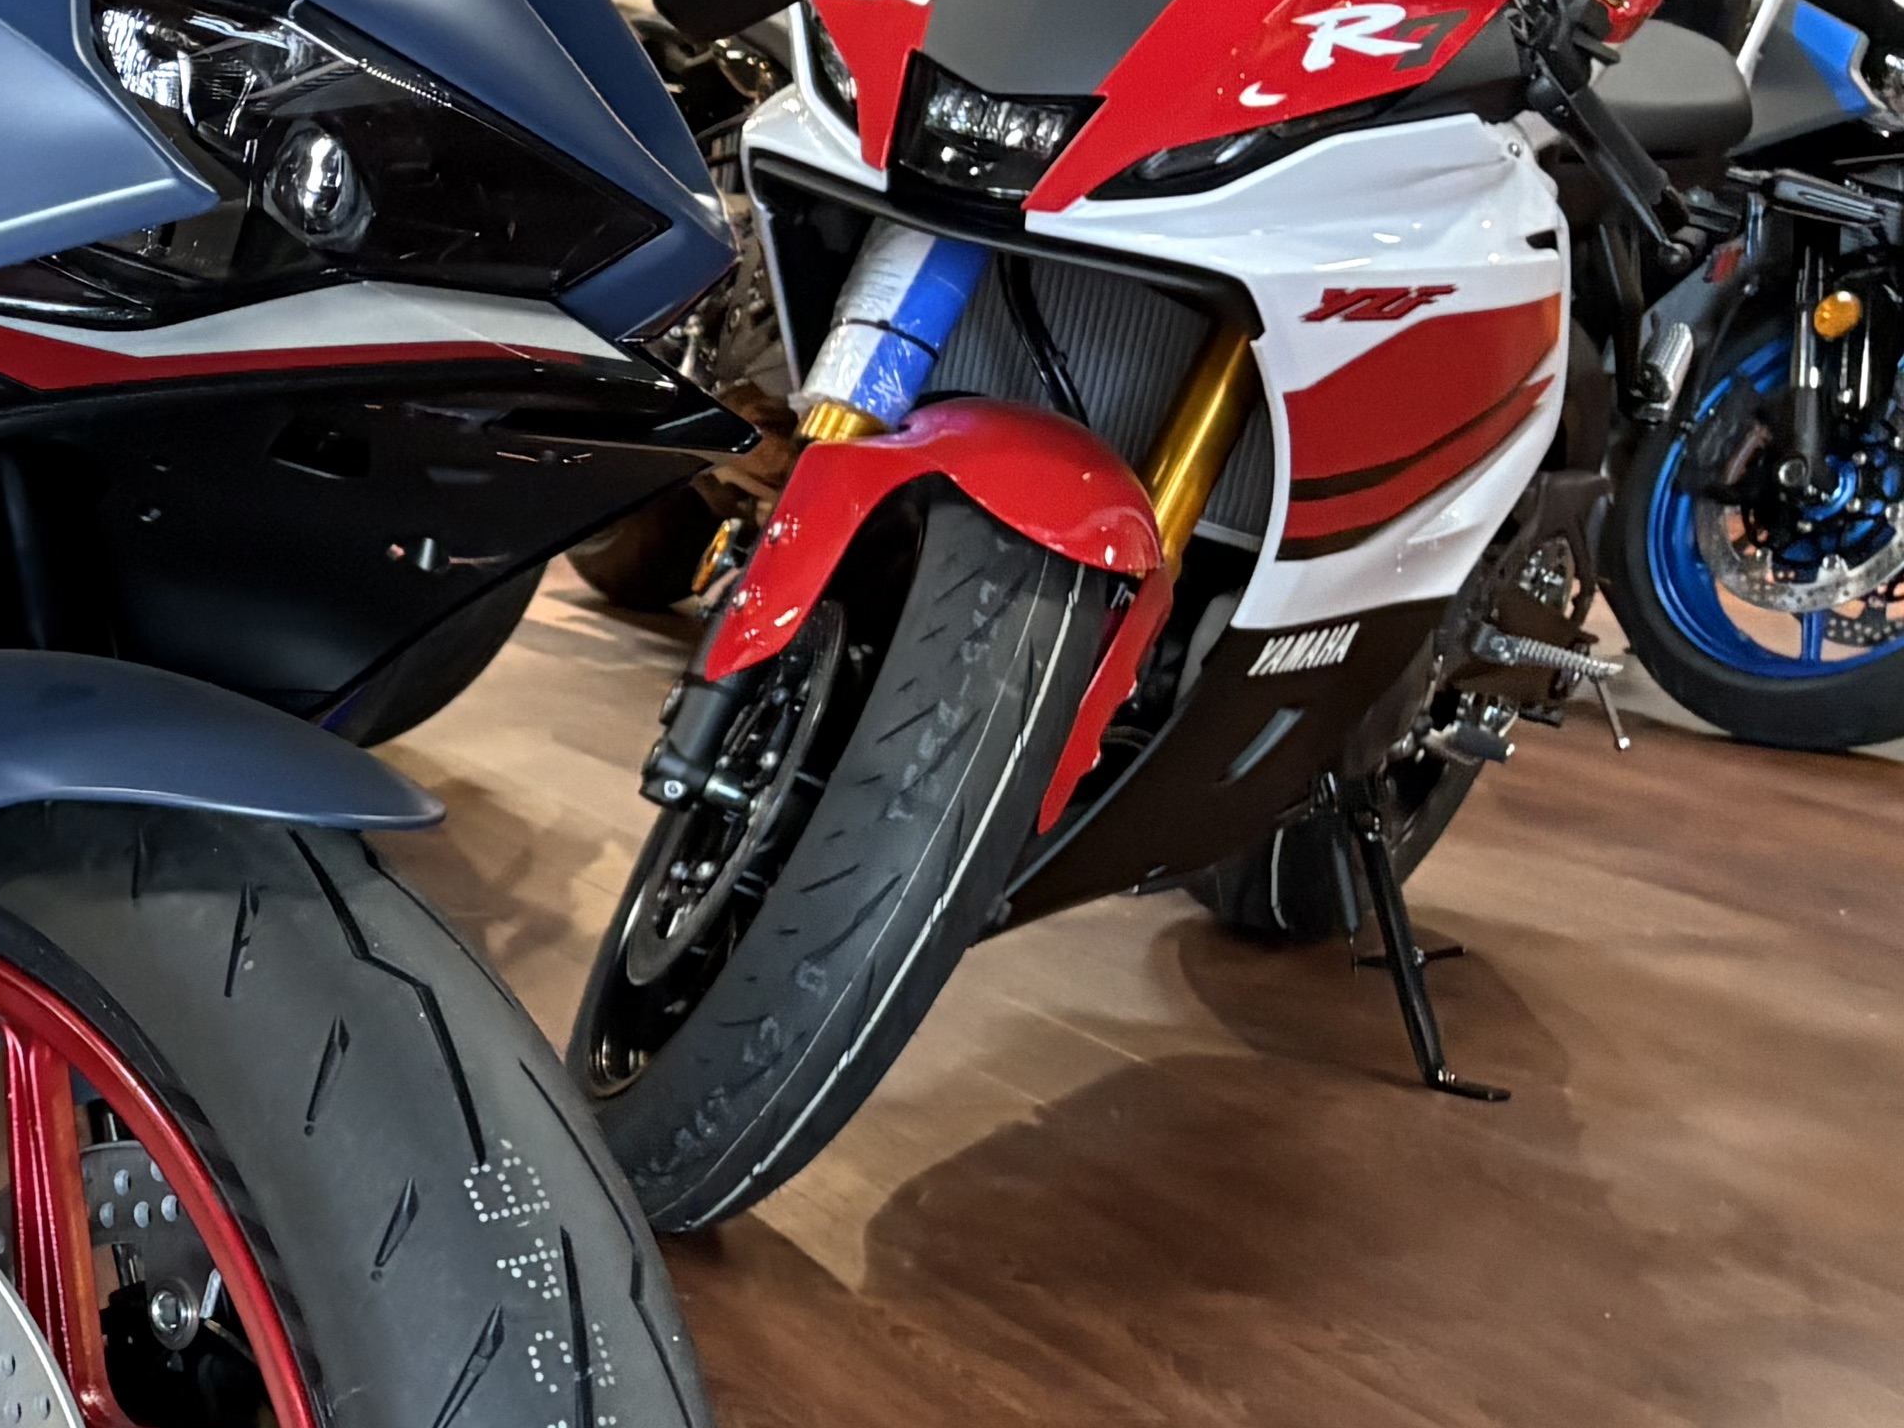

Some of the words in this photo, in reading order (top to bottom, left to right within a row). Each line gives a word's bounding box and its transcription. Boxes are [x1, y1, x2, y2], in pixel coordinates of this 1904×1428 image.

[1290, 2, 1471, 73] R7
[1298, 283, 1460, 323] YZF
[1246, 620, 1361, 677] YAMAHA
